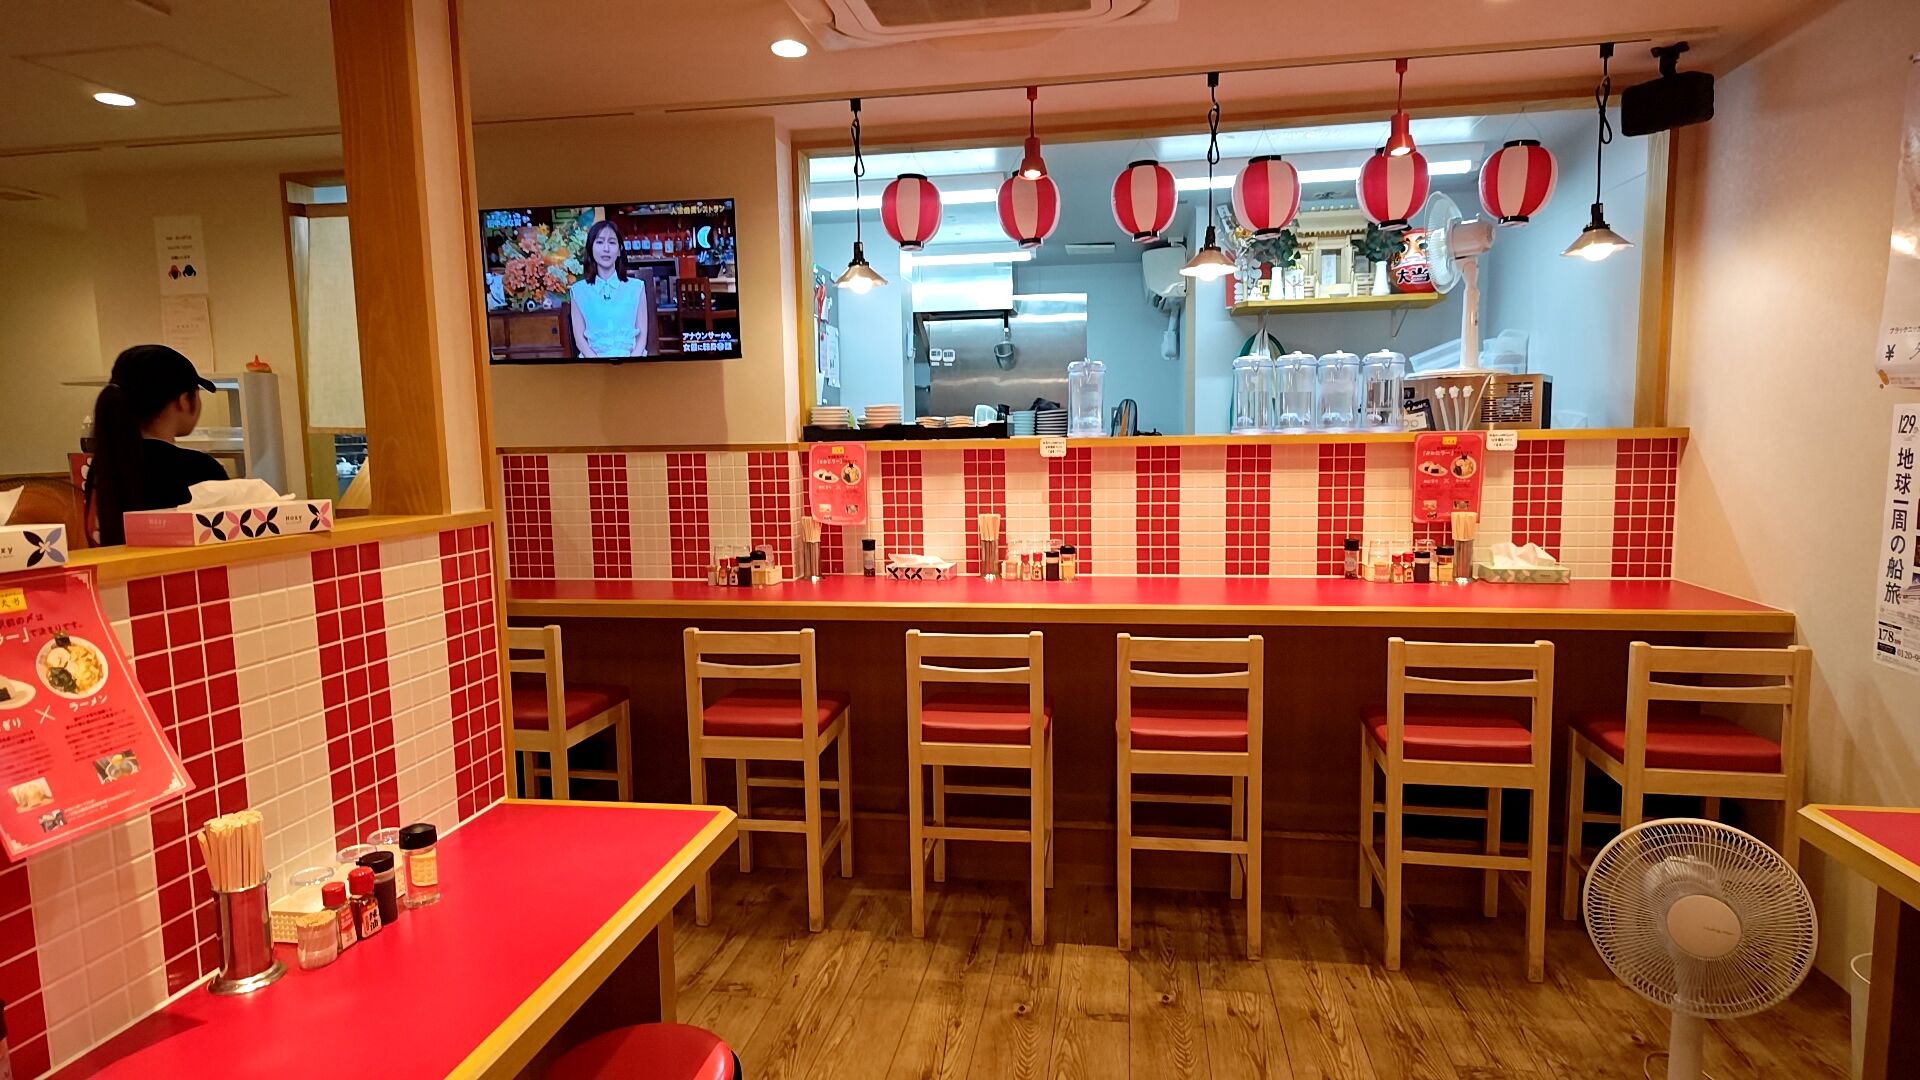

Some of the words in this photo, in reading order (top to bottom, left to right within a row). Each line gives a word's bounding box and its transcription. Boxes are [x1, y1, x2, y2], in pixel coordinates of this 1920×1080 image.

[682, 331, 732, 340] アナウンサーから
[1898, 415, 1916, 434] 129
[1884, 447, 1914, 604] 地球一周の船旅
[1879, 628, 1894, 642] 178
[69, 695, 107, 712] ラーメン
